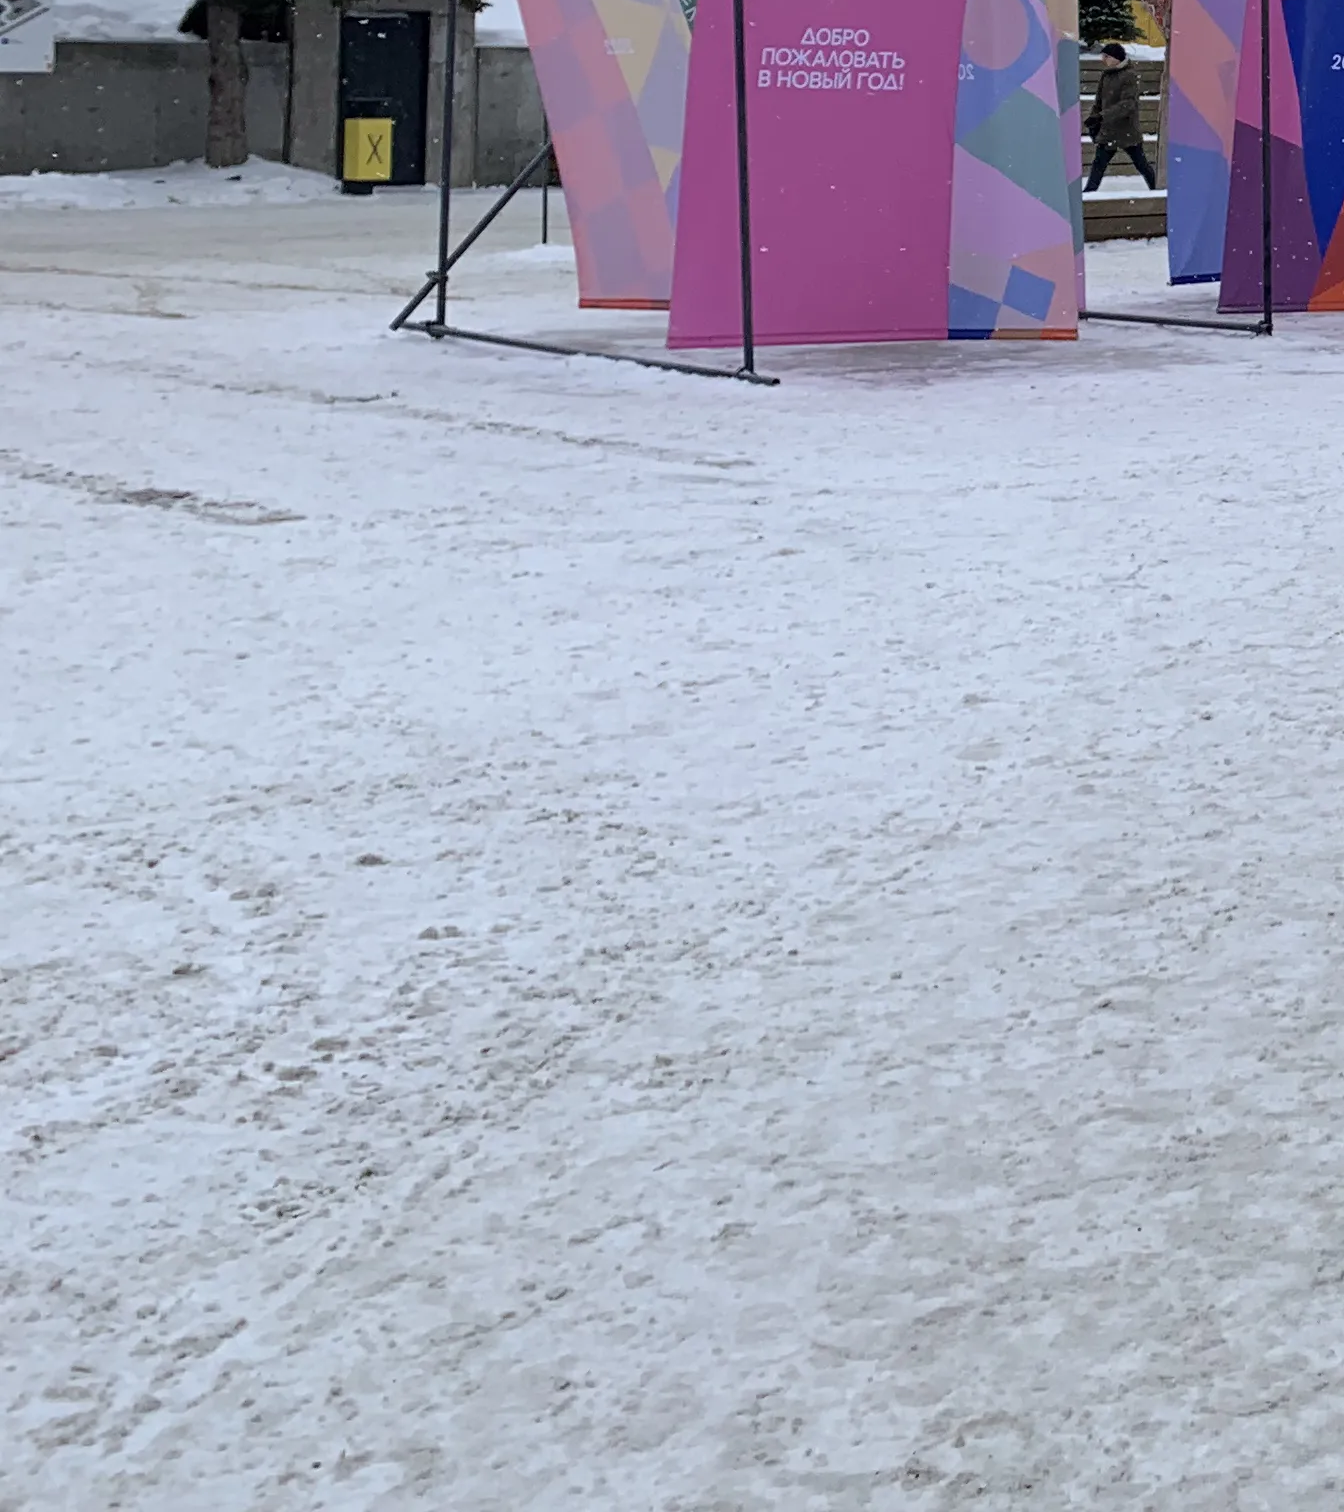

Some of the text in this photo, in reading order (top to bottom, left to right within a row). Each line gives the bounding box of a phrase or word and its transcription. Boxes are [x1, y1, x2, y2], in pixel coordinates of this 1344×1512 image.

[800, 27, 870, 47] ДОБРО
[761, 47, 905, 69] ПОЖАЛОВАТЬ
[757, 68, 905, 91] В НОВЫЙ ГОД!
